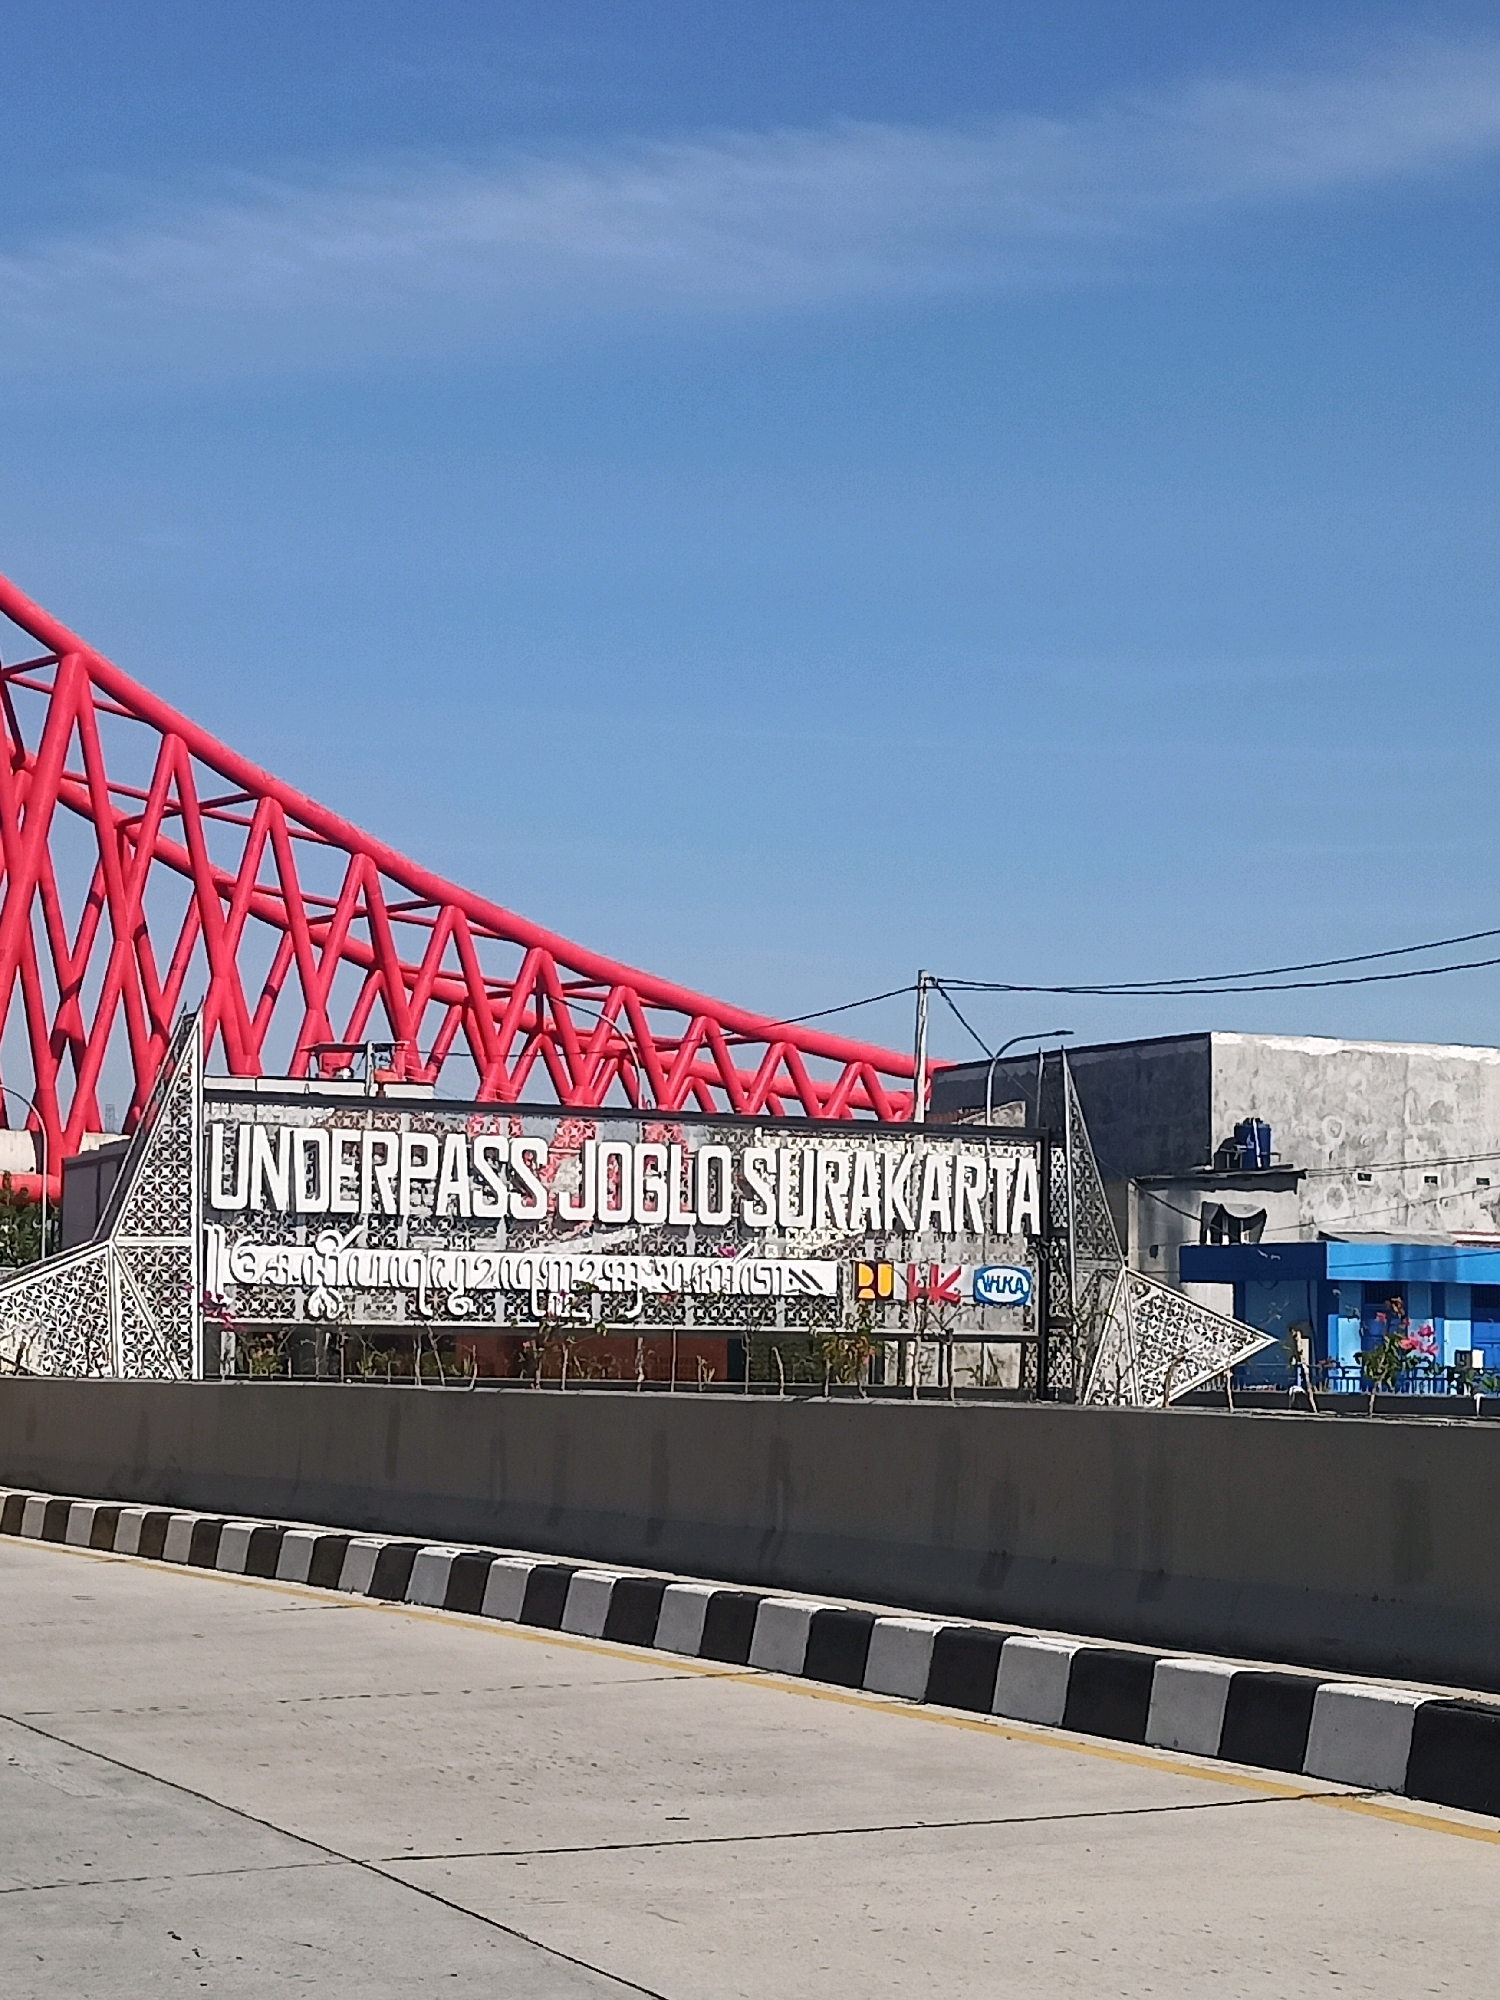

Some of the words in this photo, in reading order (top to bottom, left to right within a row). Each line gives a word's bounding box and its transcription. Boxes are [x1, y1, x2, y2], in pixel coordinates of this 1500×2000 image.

[210, 1122, 550, 1220] UNDERPASS
[557, 1138, 733, 1227] JOGLO
[742, 1146, 1042, 1236] SURAKARTA
